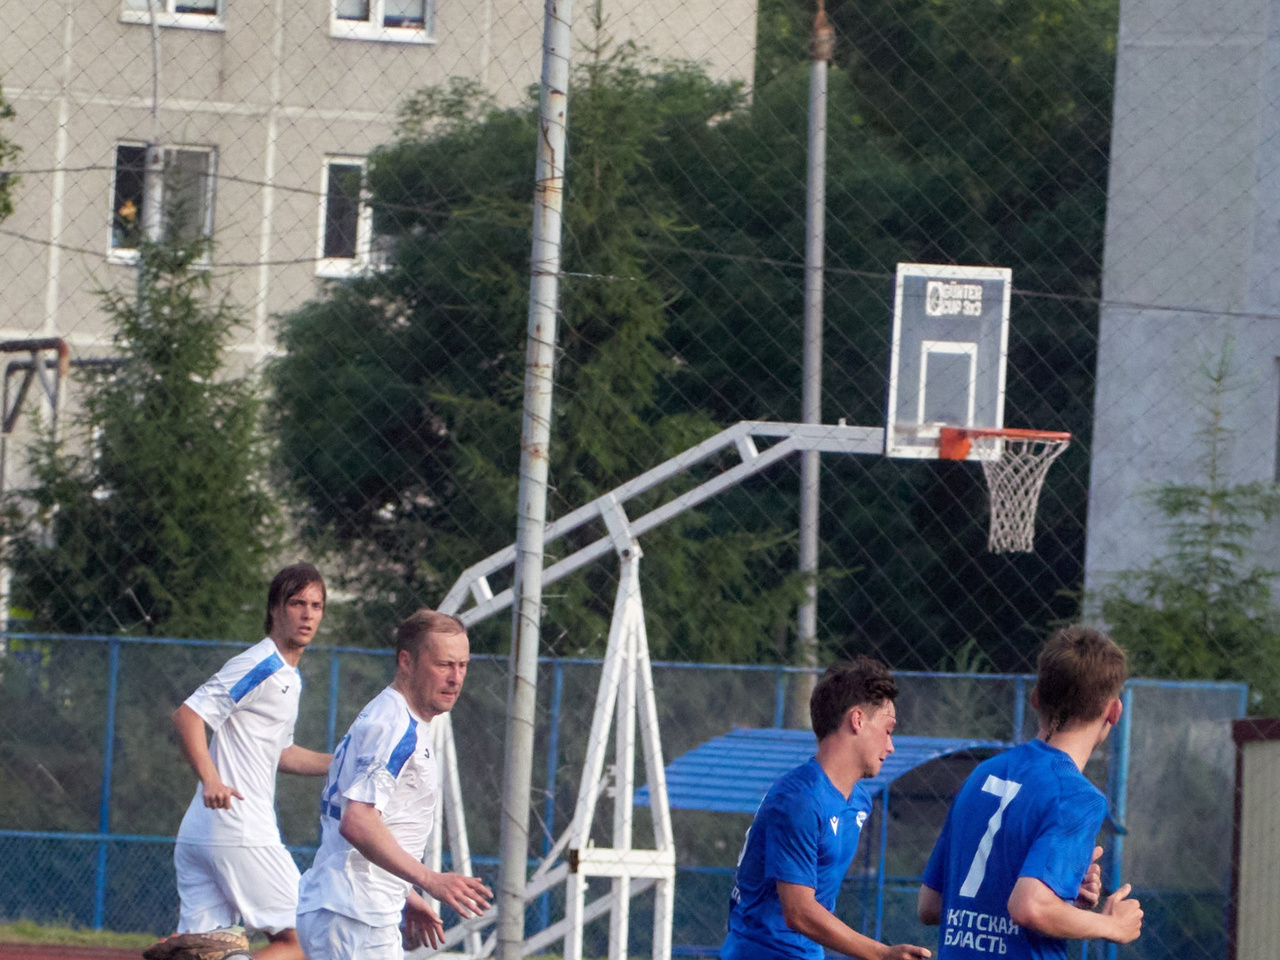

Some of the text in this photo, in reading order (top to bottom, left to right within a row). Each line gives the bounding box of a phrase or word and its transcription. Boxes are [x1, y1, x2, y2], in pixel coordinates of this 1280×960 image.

[961, 774, 1023, 898] 7
[947, 908, 1020, 936] КУТСКАЯ
[944, 928, 1008, 955] БЛАСТЬ
